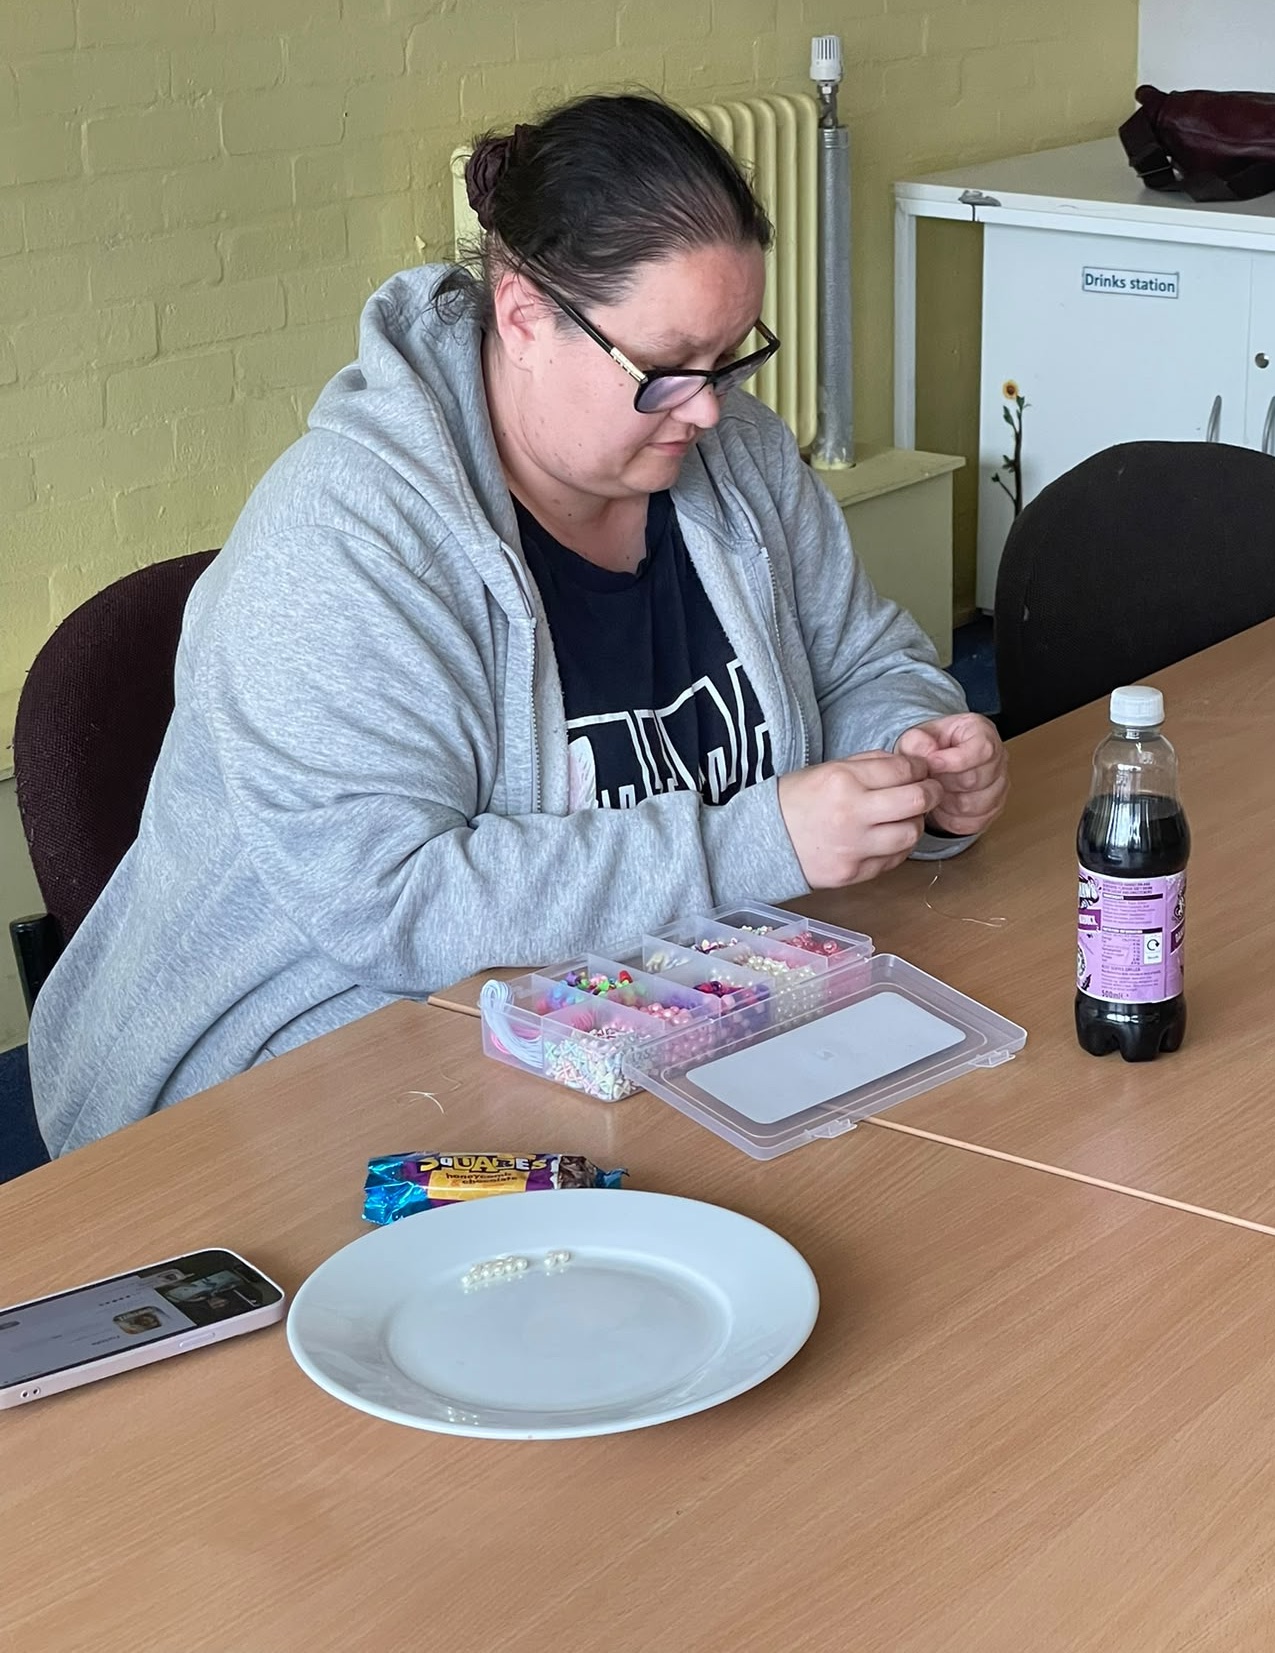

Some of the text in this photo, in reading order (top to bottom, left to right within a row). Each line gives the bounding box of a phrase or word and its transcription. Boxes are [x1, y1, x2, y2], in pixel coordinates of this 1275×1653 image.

[1085, 273, 1175, 293] Drinks station
[445, 1172, 512, 1180] honeycomb
[462, 1175, 518, 1184] chocolate
